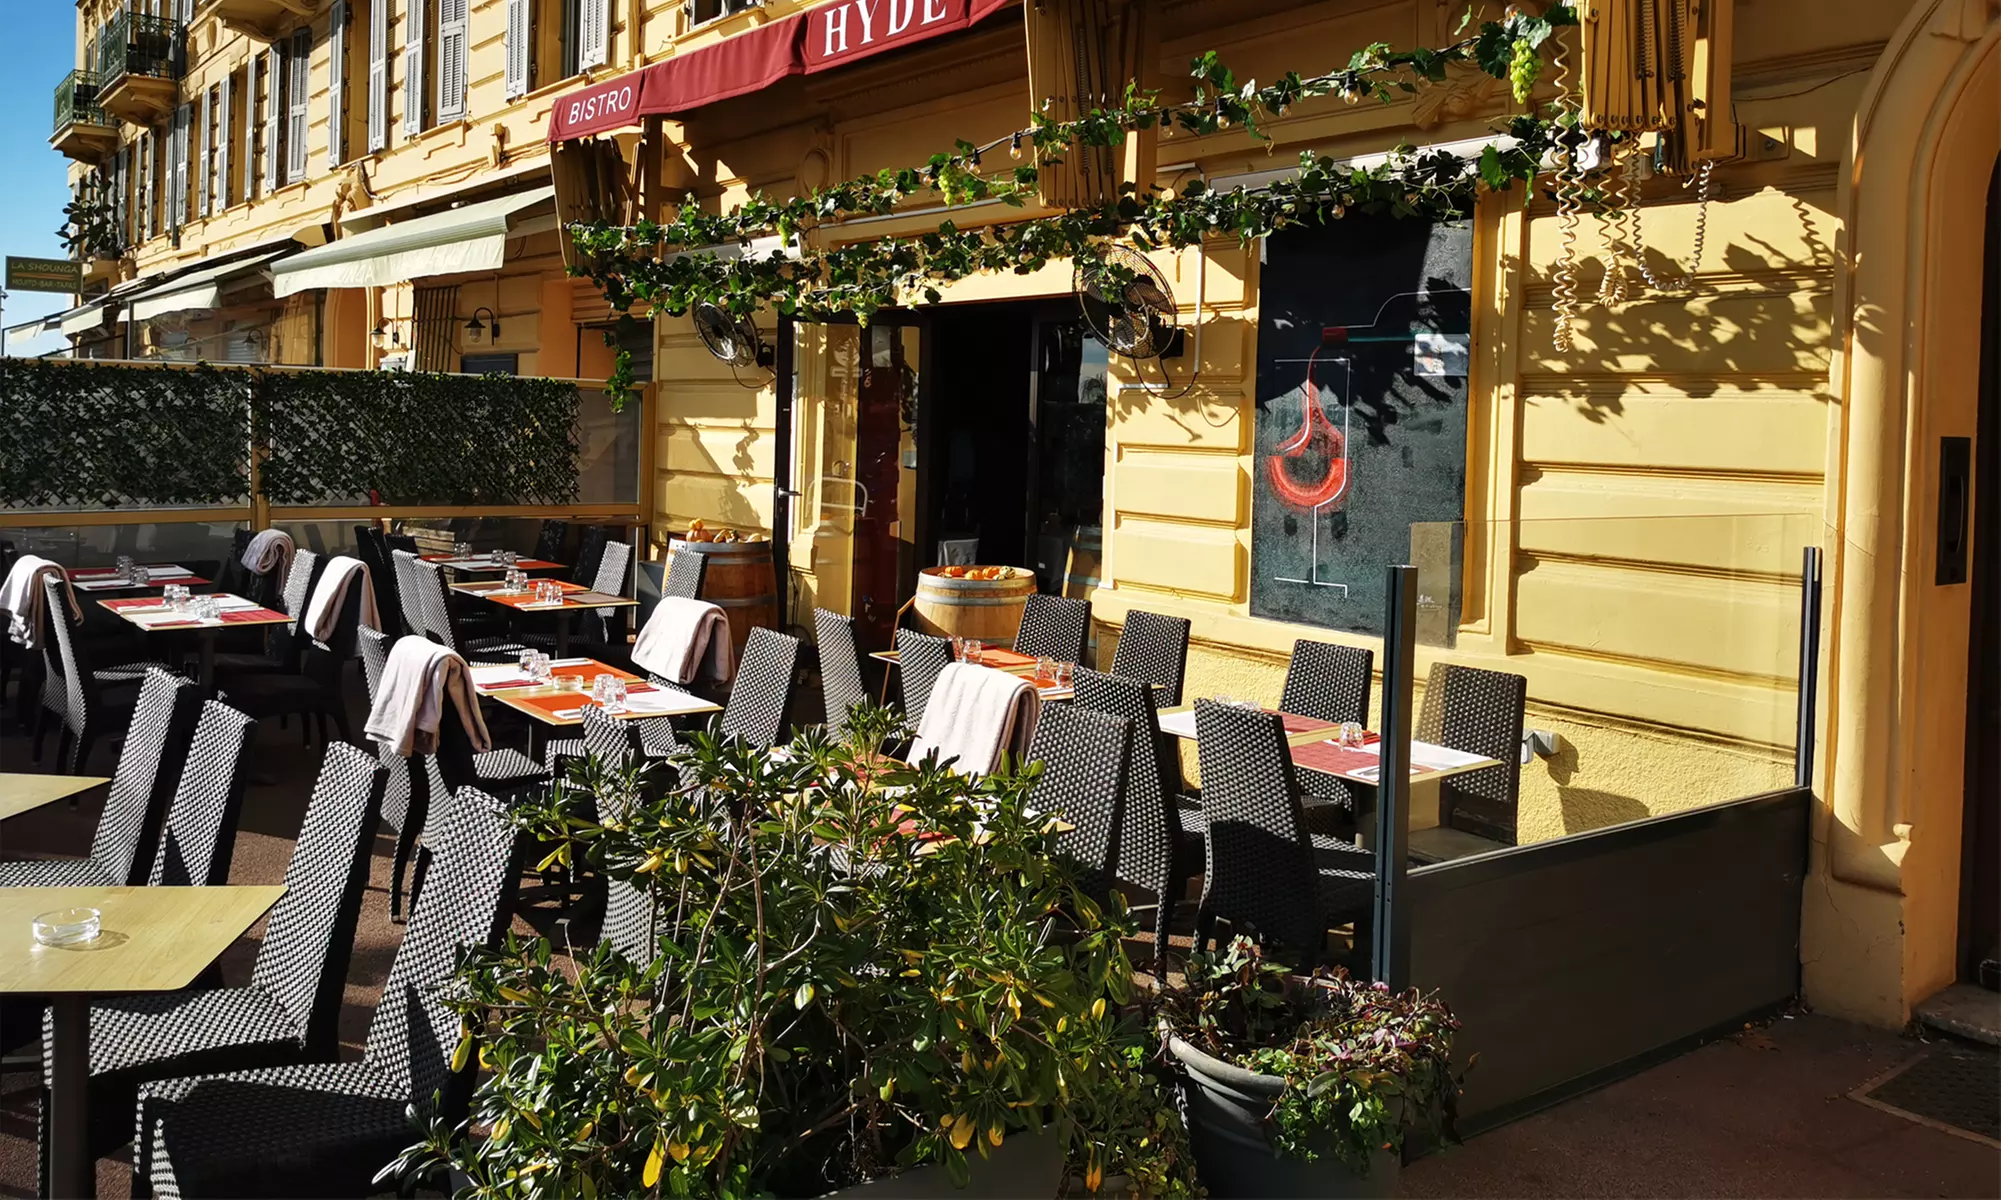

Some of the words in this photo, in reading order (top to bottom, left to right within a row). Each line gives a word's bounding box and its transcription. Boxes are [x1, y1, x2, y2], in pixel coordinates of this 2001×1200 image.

[568, 86, 632, 125] BISTRO
[11, 262, 25, 270] LA
[28, 262, 79, 274] SHOUNGA
